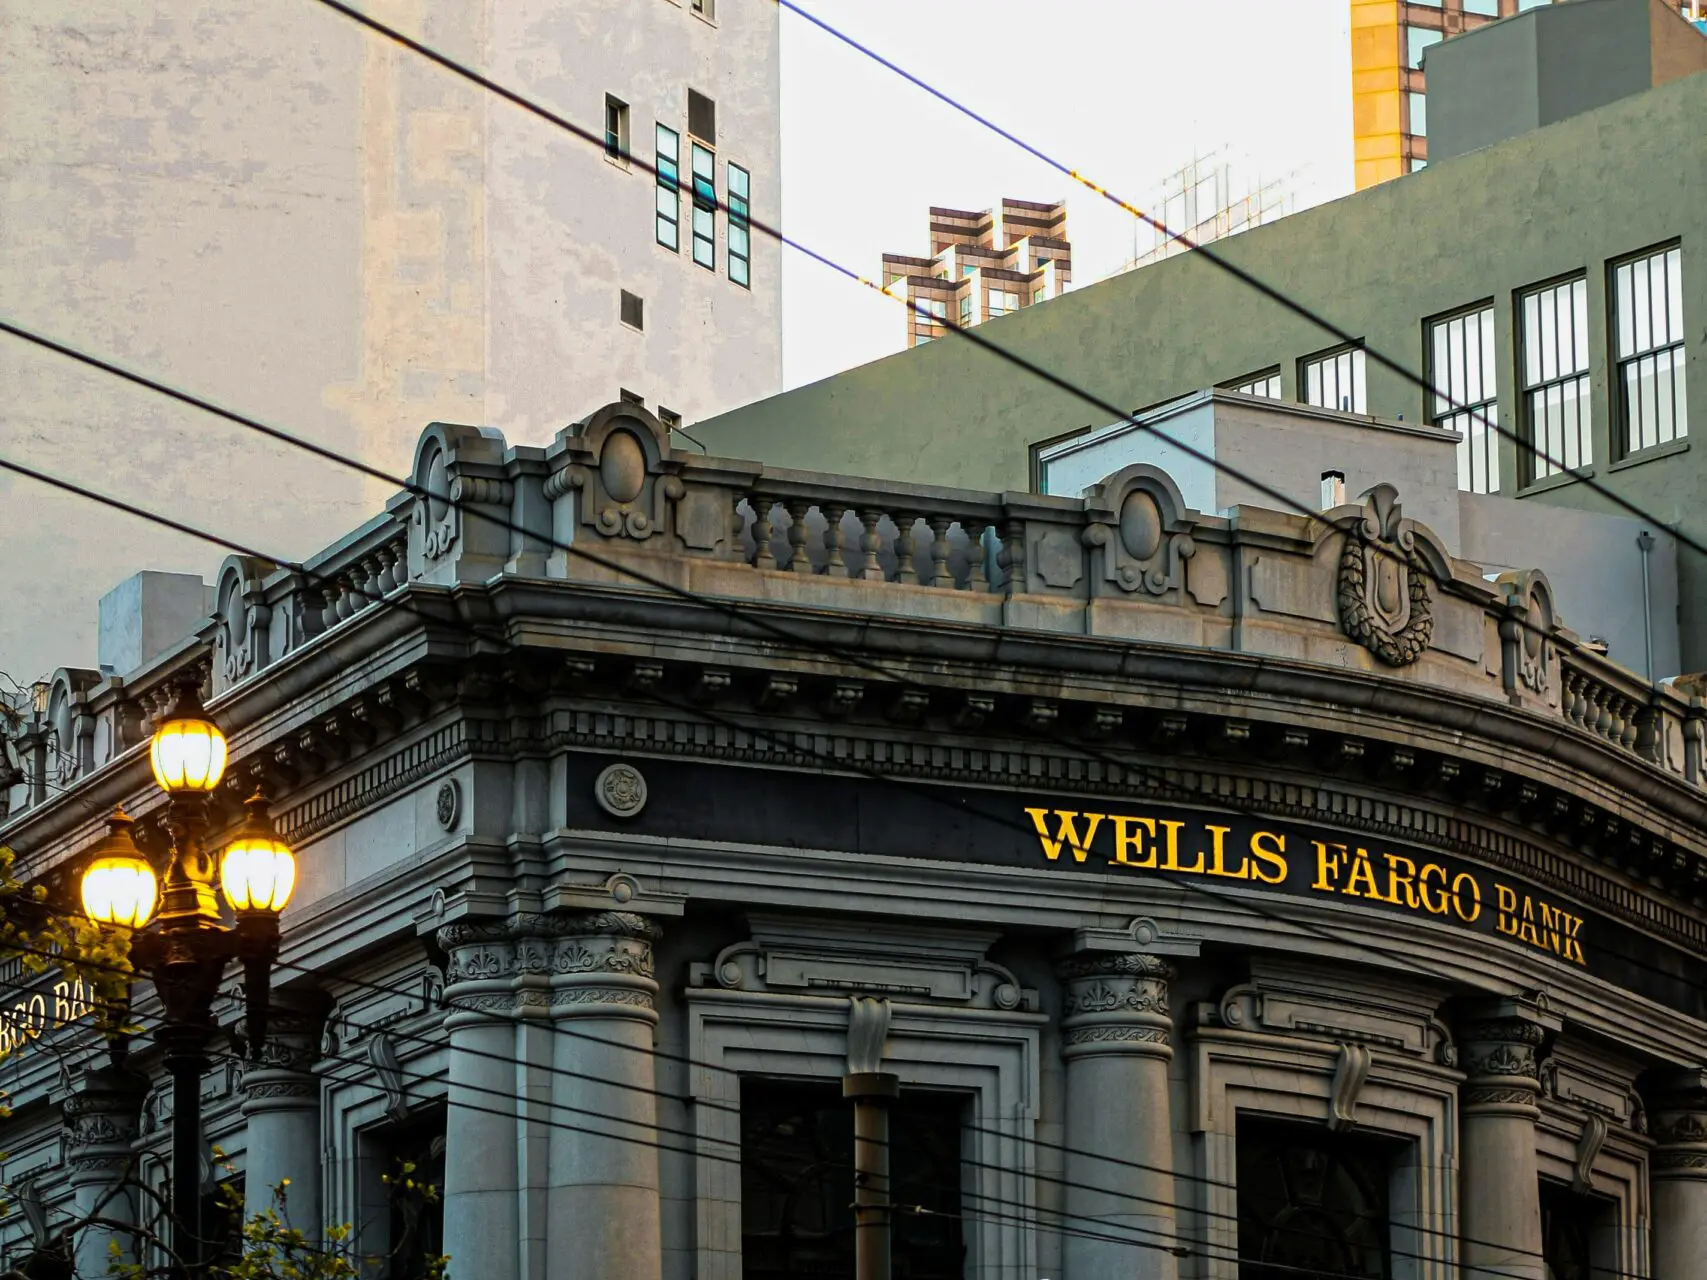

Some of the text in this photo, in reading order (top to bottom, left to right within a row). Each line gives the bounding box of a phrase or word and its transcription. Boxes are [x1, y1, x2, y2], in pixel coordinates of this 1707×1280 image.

[1024, 806, 1587, 966] WELLS FARGO BANK
